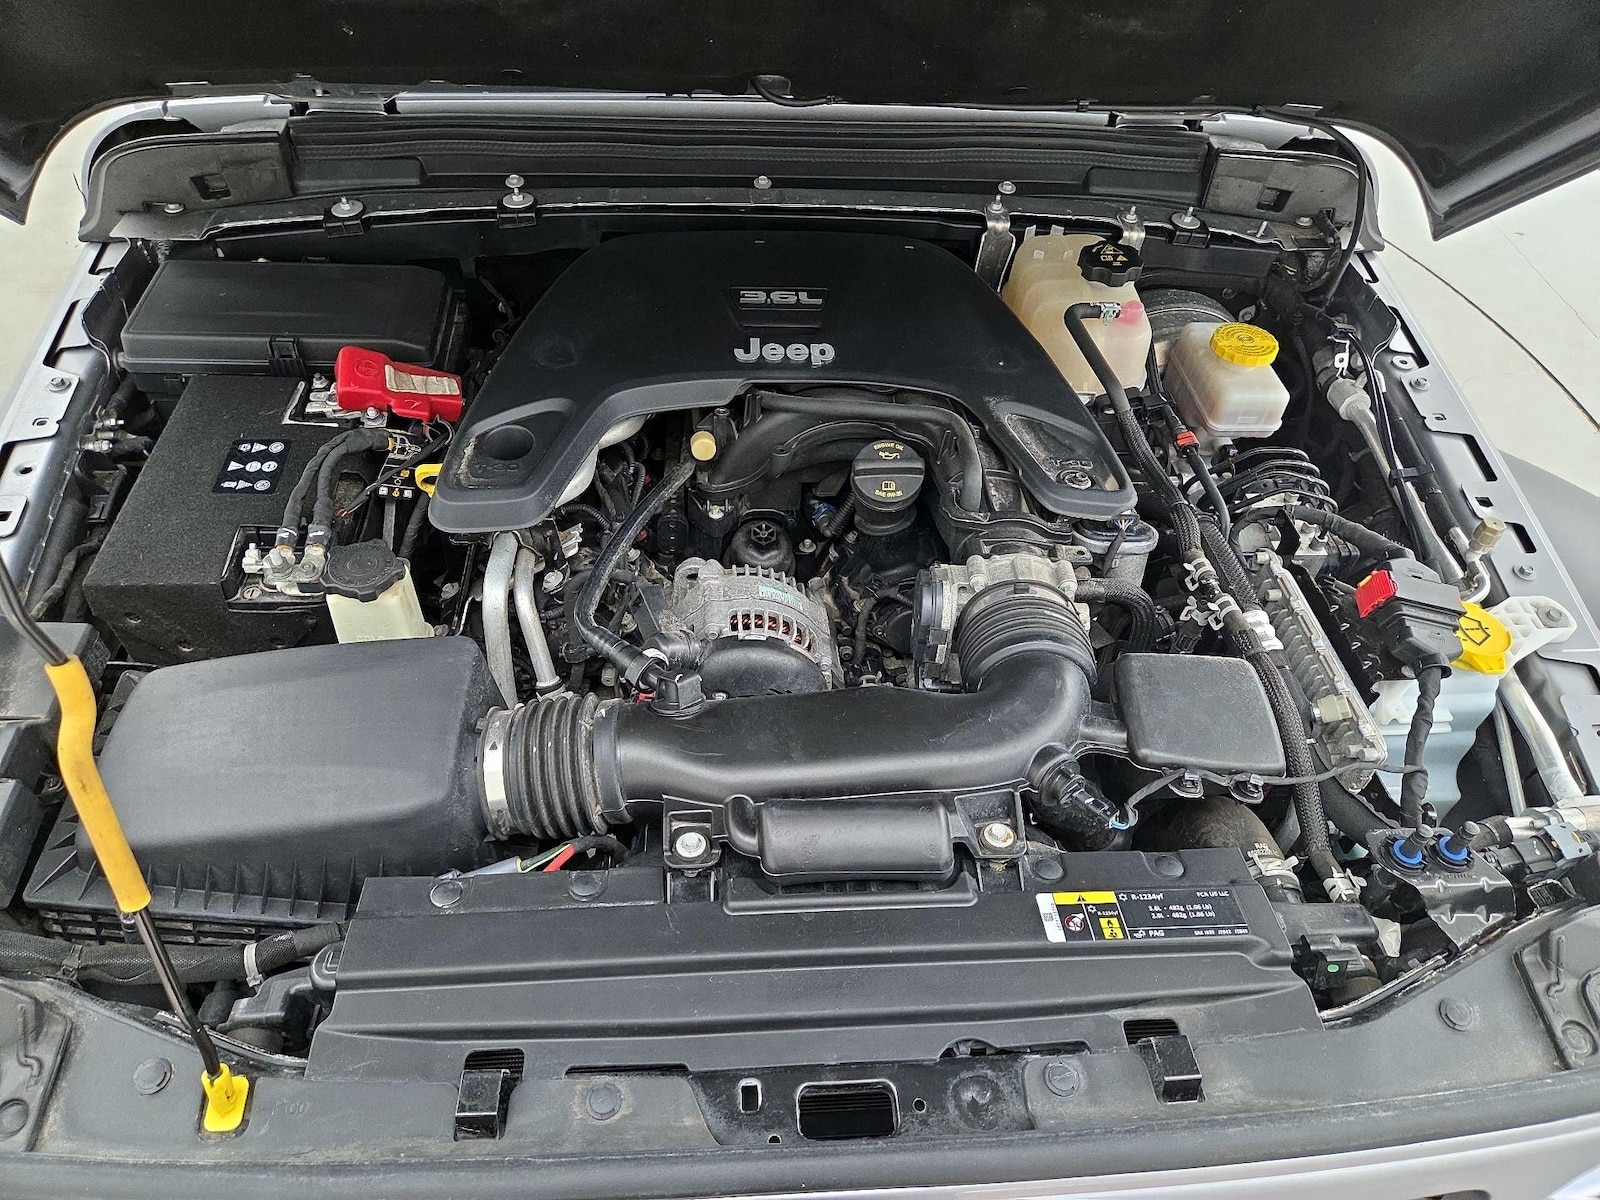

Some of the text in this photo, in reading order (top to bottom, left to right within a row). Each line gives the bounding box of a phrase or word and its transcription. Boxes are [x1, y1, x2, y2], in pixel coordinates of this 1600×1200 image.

[740, 290, 823, 305] 3.6L
[733, 337, 836, 368] Jeep
[873, 442, 904, 451] ENGINE OIL
[874, 489, 887, 497] SAE
[1130, 892, 1164, 901] R-1234yf
[1148, 929, 1165, 937] PAG
